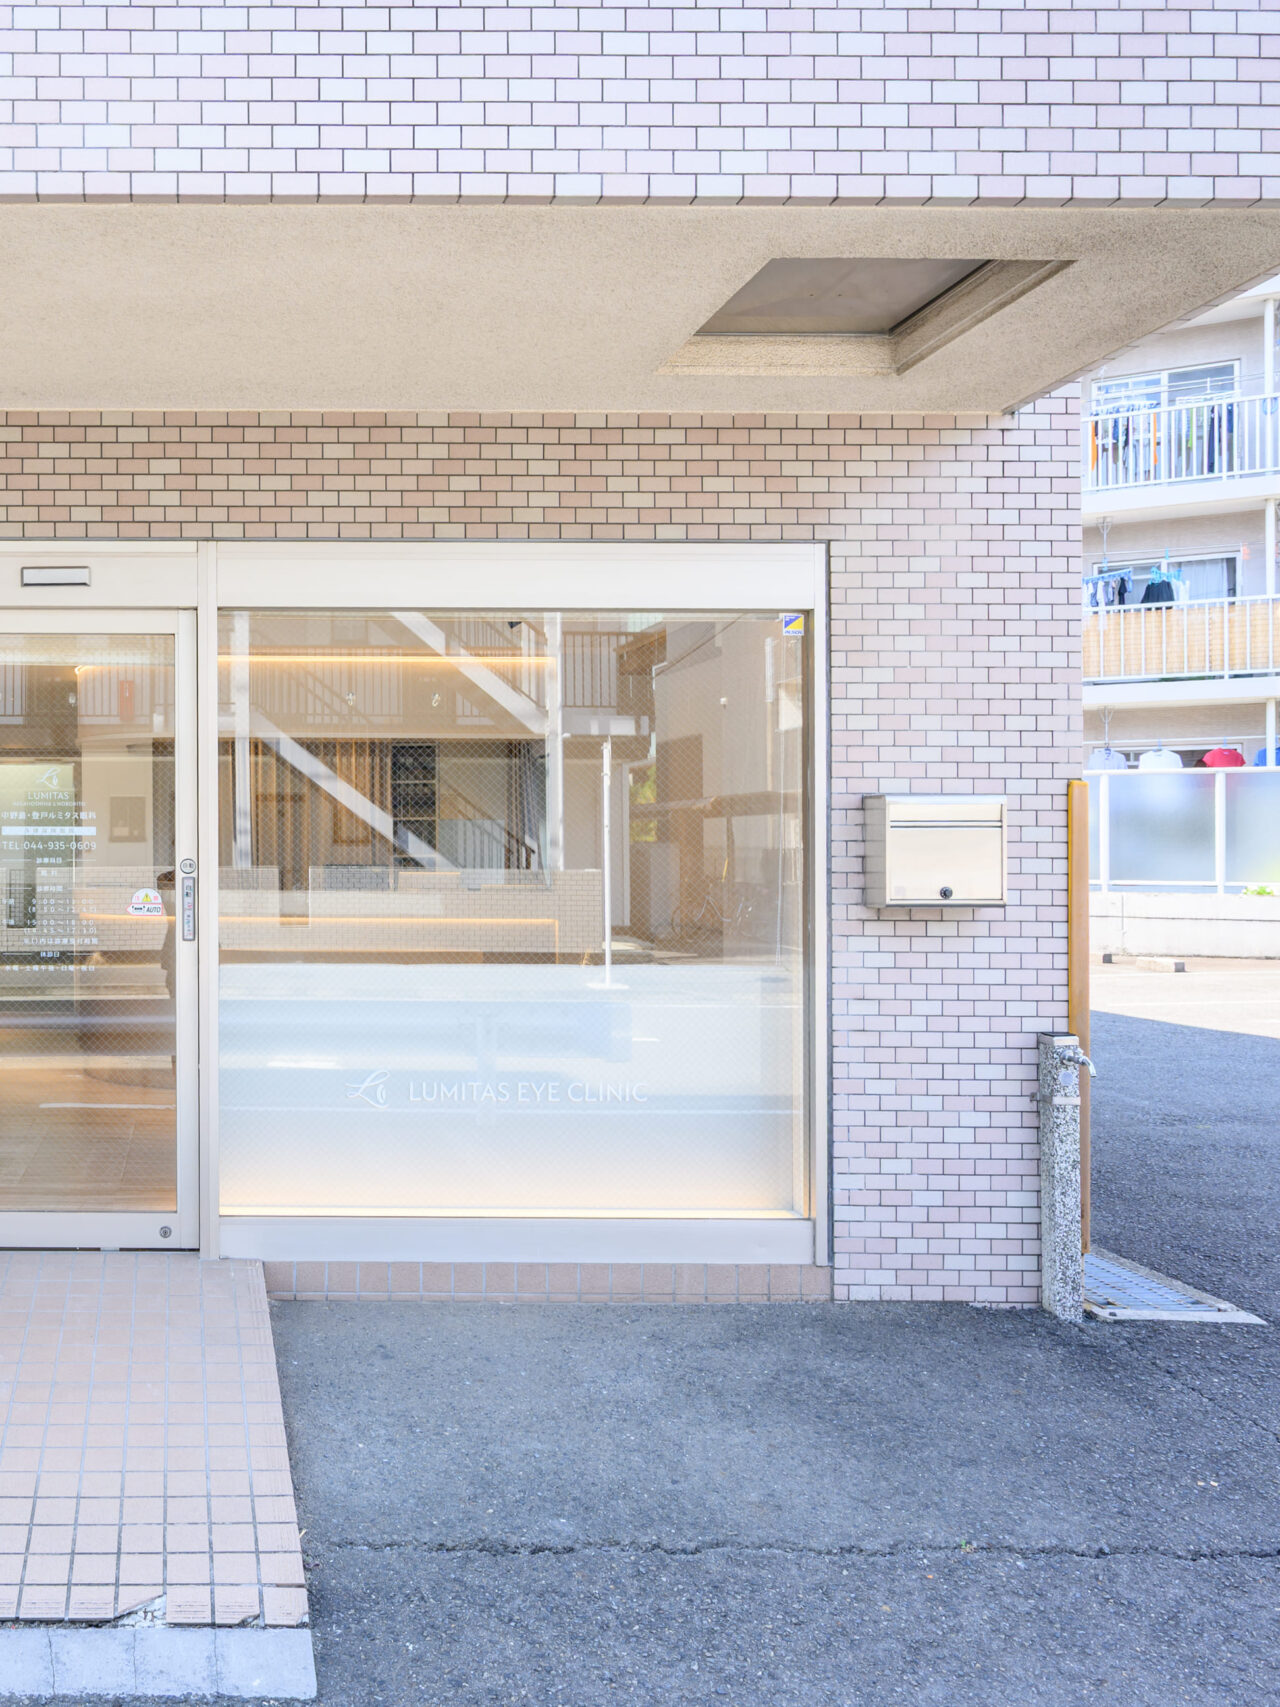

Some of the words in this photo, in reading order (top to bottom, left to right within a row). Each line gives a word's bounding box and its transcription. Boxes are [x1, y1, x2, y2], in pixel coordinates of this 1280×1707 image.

[27, 791, 70, 800] LUMITAS
[2, 841, 20, 850] TEL
[23, 841, 97, 850] 044-935-0609
[408, 1081, 513, 1102] LUMITAS
[517, 1081, 561, 1102] EYE
[567, 1081, 649, 1102] CLINIC
